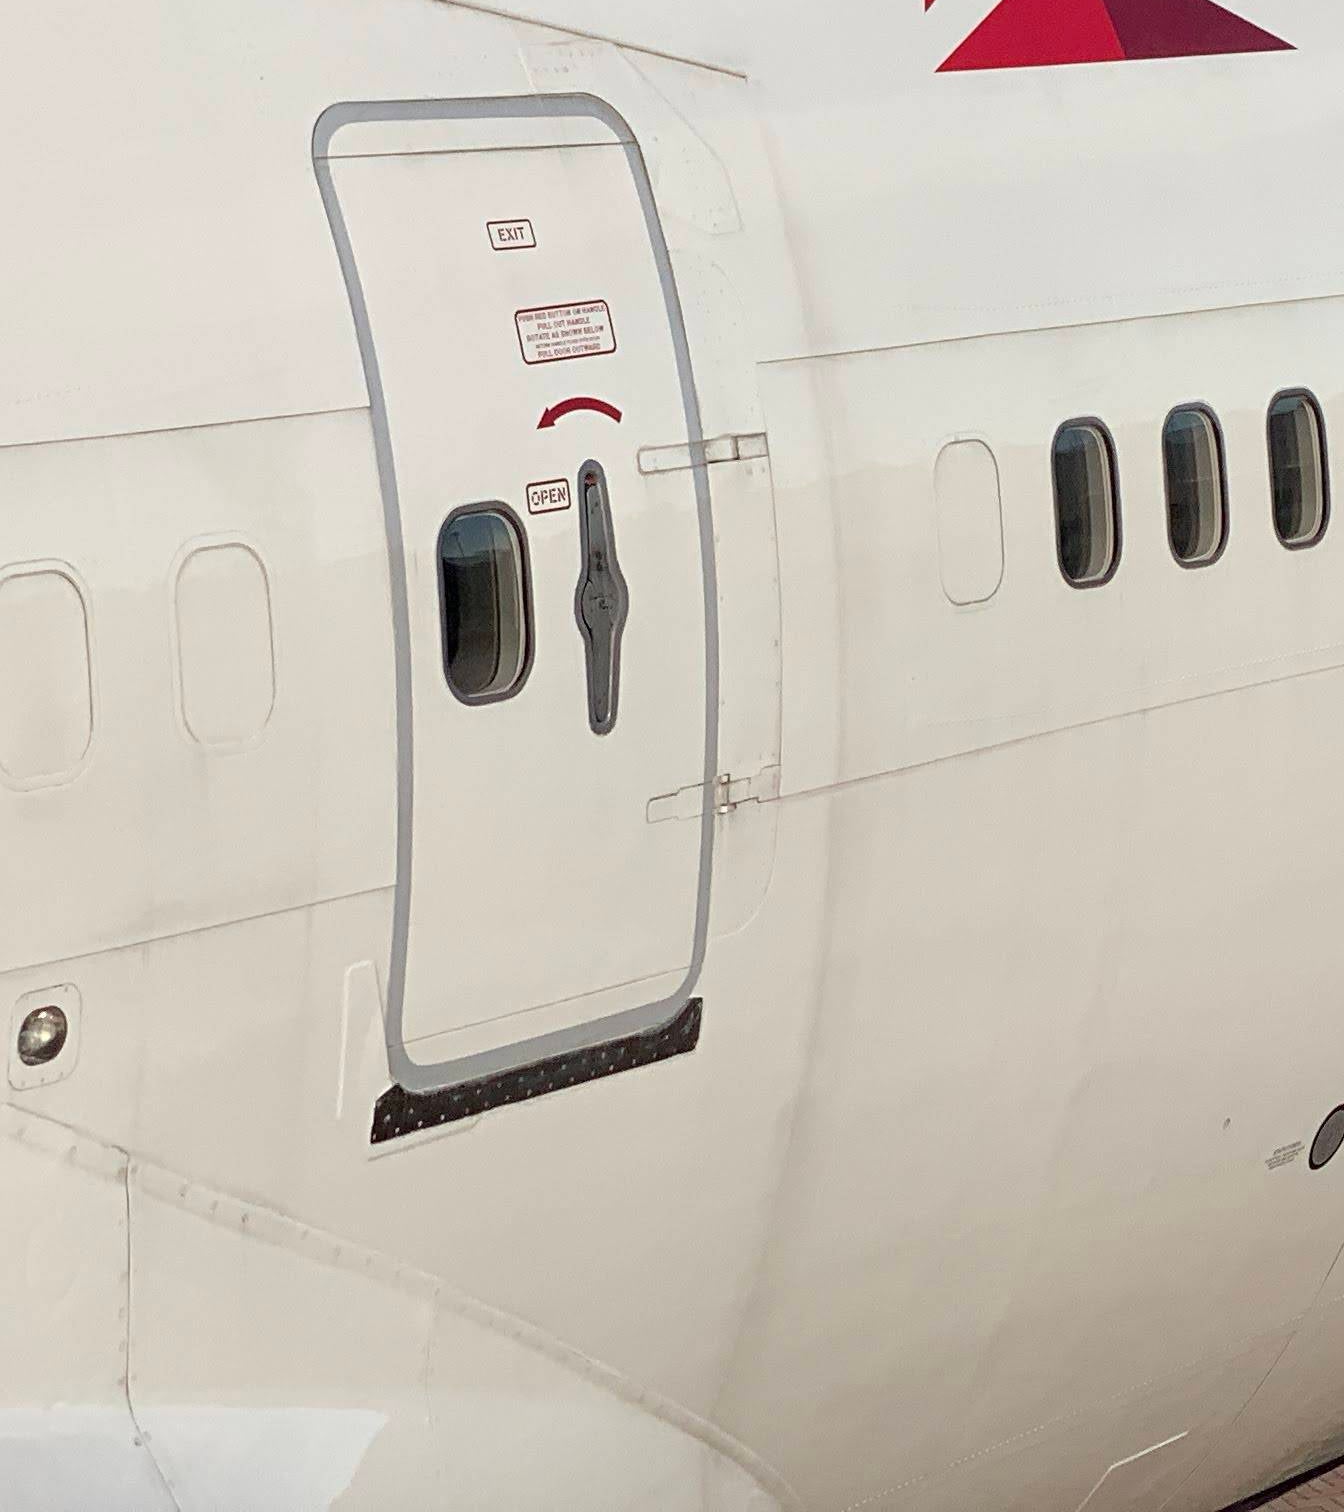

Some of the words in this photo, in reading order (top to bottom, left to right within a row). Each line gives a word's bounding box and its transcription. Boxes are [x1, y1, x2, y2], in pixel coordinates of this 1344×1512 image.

[497, 226, 524, 242] EXIT
[566, 316, 591, 326] HANDLE
[531, 487, 567, 506] OPEN
